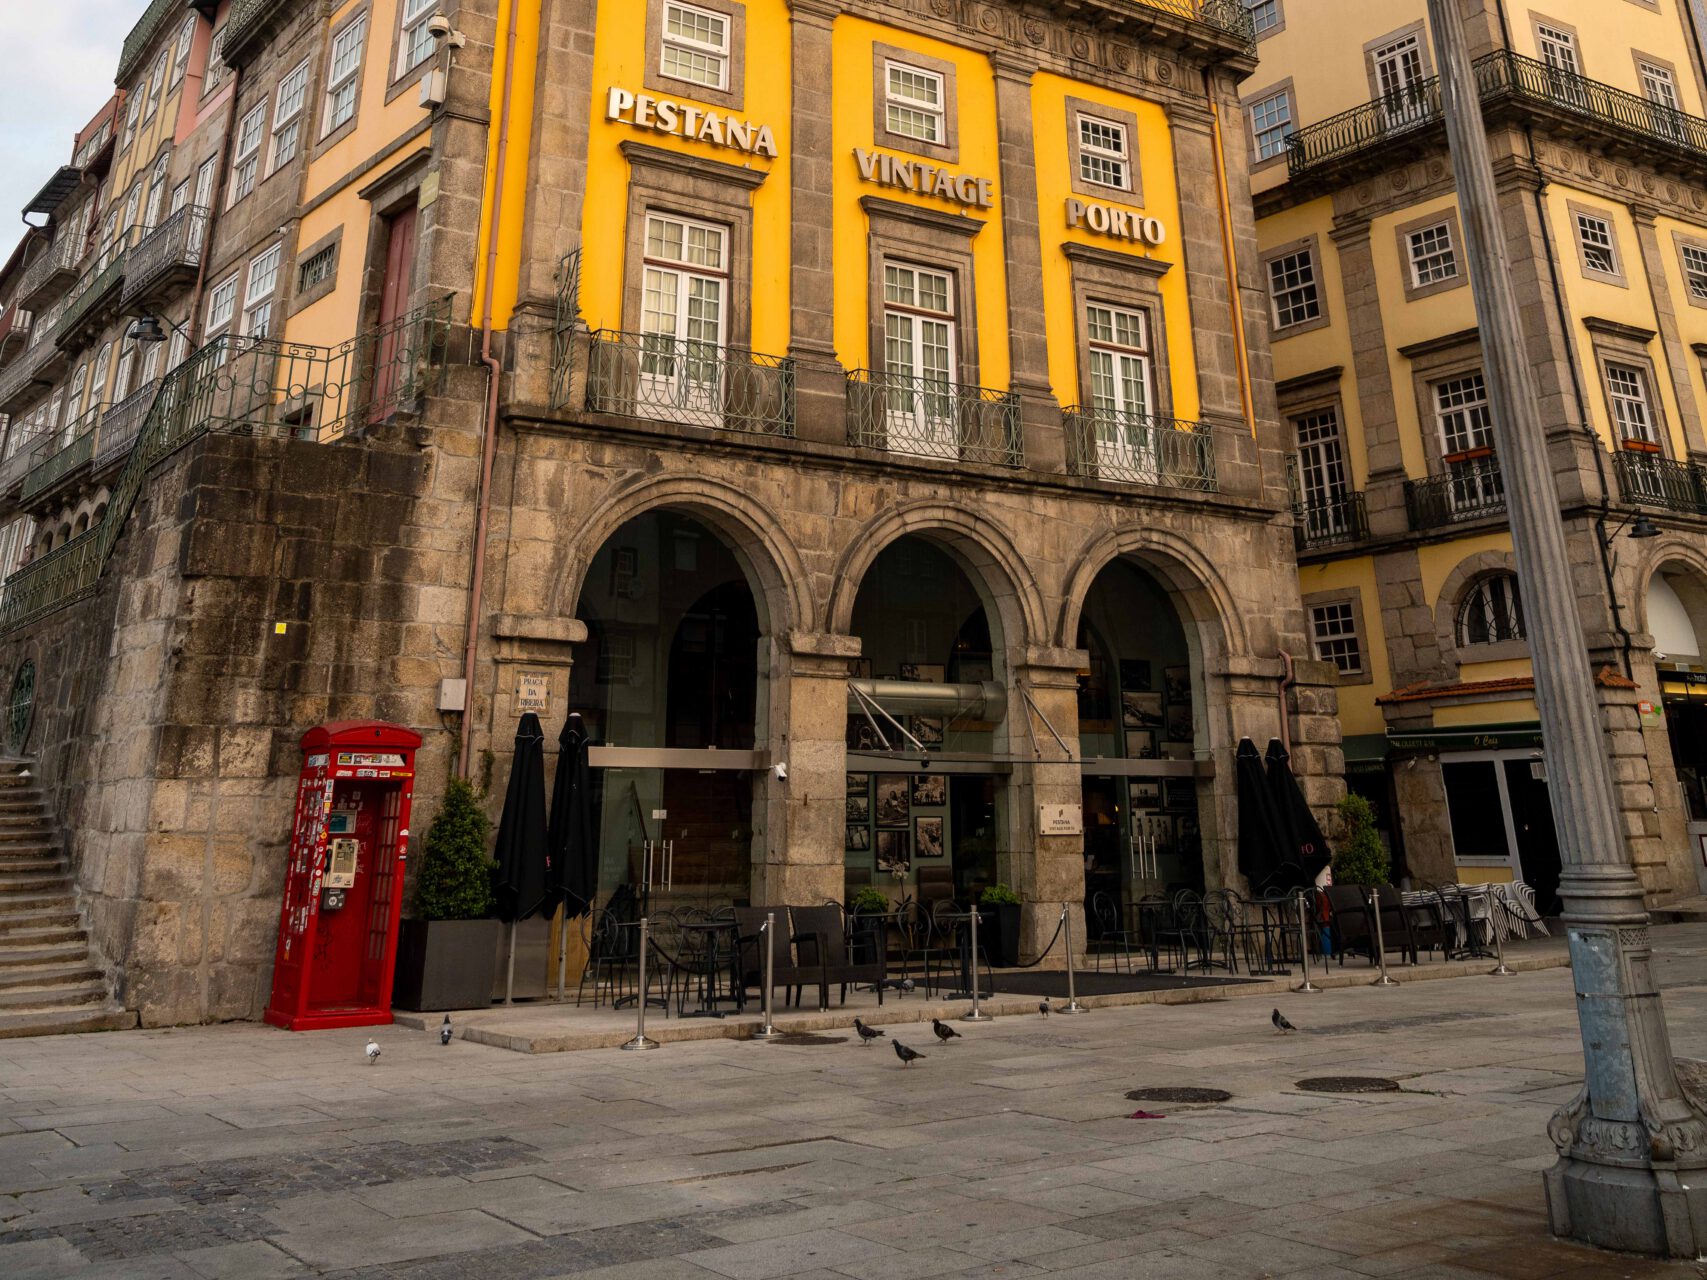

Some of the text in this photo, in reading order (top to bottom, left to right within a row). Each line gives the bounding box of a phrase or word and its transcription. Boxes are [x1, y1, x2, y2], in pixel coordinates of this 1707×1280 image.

[605, 86, 778, 158] PESTANA
[853, 147, 993, 208] VINTAGE
[1065, 198, 1166, 245] PORTO
[528, 688, 536, 696] DA
